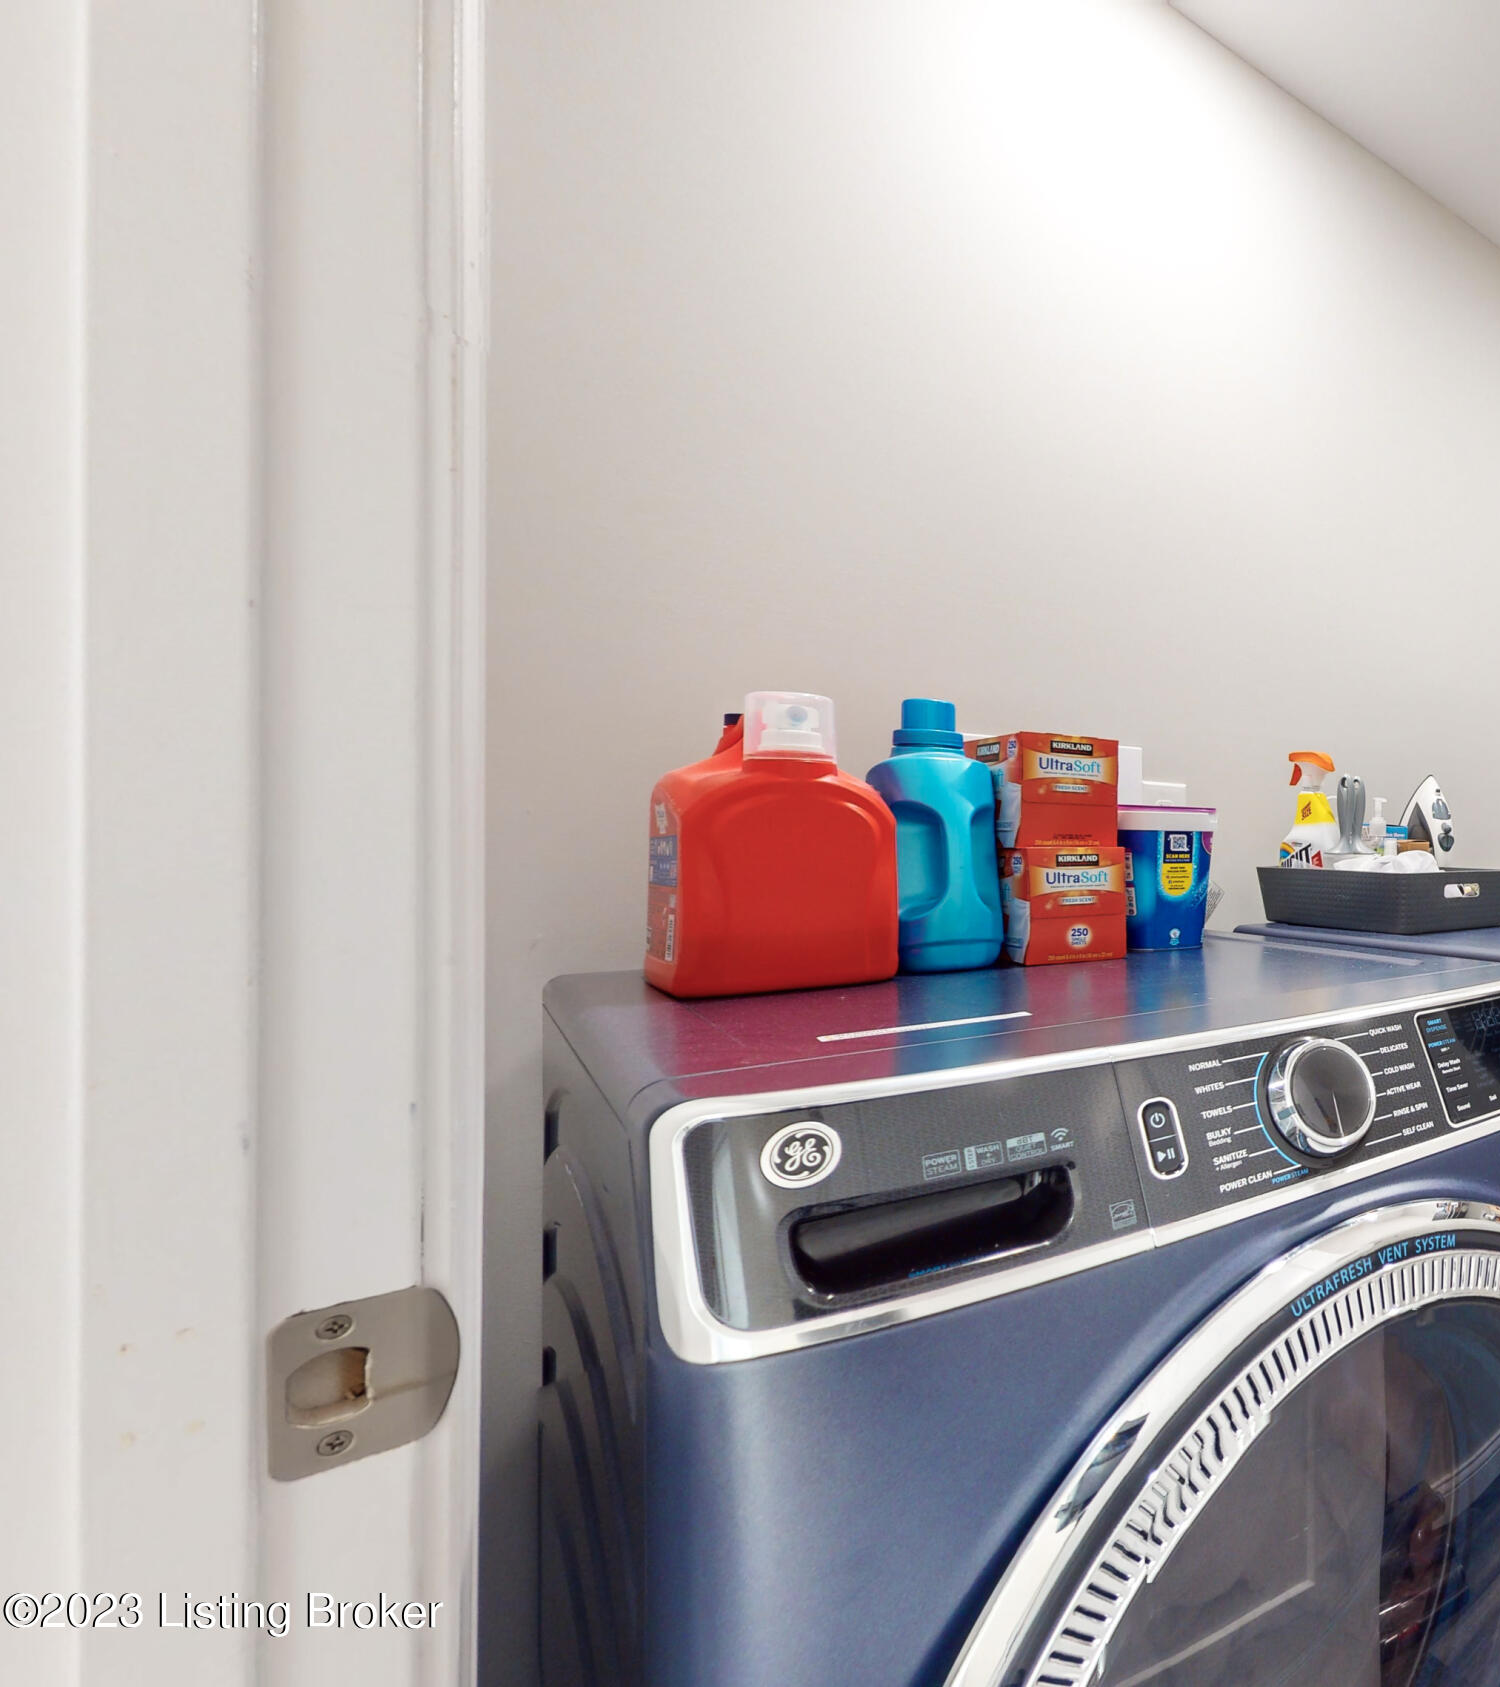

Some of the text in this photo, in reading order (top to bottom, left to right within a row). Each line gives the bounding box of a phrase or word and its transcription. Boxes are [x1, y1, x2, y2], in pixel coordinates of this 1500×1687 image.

[1052, 742, 1093, 751] KIRKLAND
[1038, 756, 1101, 774] UltraSoft
[1058, 855, 1098, 863] KIRKLAND
[1046, 870, 1108, 885] UltraSoft
[1071, 928, 1089, 937] 250
[1368, 1023, 1402, 1037] QUICK WASH
[1379, 1042, 1409, 1055] DELICATES
[1188, 1059, 1222, 1072] NORMAL
[1384, 1062, 1416, 1075] COLD WASH
[1437, 1060, 1450, 1069] Delay
[1194, 1081, 1225, 1095] WHITES
[1386, 1081, 1421, 1096] ACTIVE WEAR
[1200, 1105, 1233, 1120] TOWELS
[1393, 1106, 1411, 1118] RINSE
[1415, 1102, 1429, 1111] SPIN
[1456, 1102, 1471, 1112] Sound
[1206, 1127, 1232, 1141] BULKY
[1402, 1121, 1434, 1136] SELF CLEAN
[1050, 1140, 1075, 1151] SMART
[1208, 1136, 1232, 1147] Bedding
[977, 1143, 999, 1154] WASH
[925, 1154, 957, 1166] POWER
[1213, 1149, 1248, 1165] SANITIZE
[926, 1163, 958, 1176] STEAM
[1219, 1170, 1273, 1193] POWER CLEAN
[1290, 1233, 1456, 1317] ULTRAFRESH VENT SYSTEM
